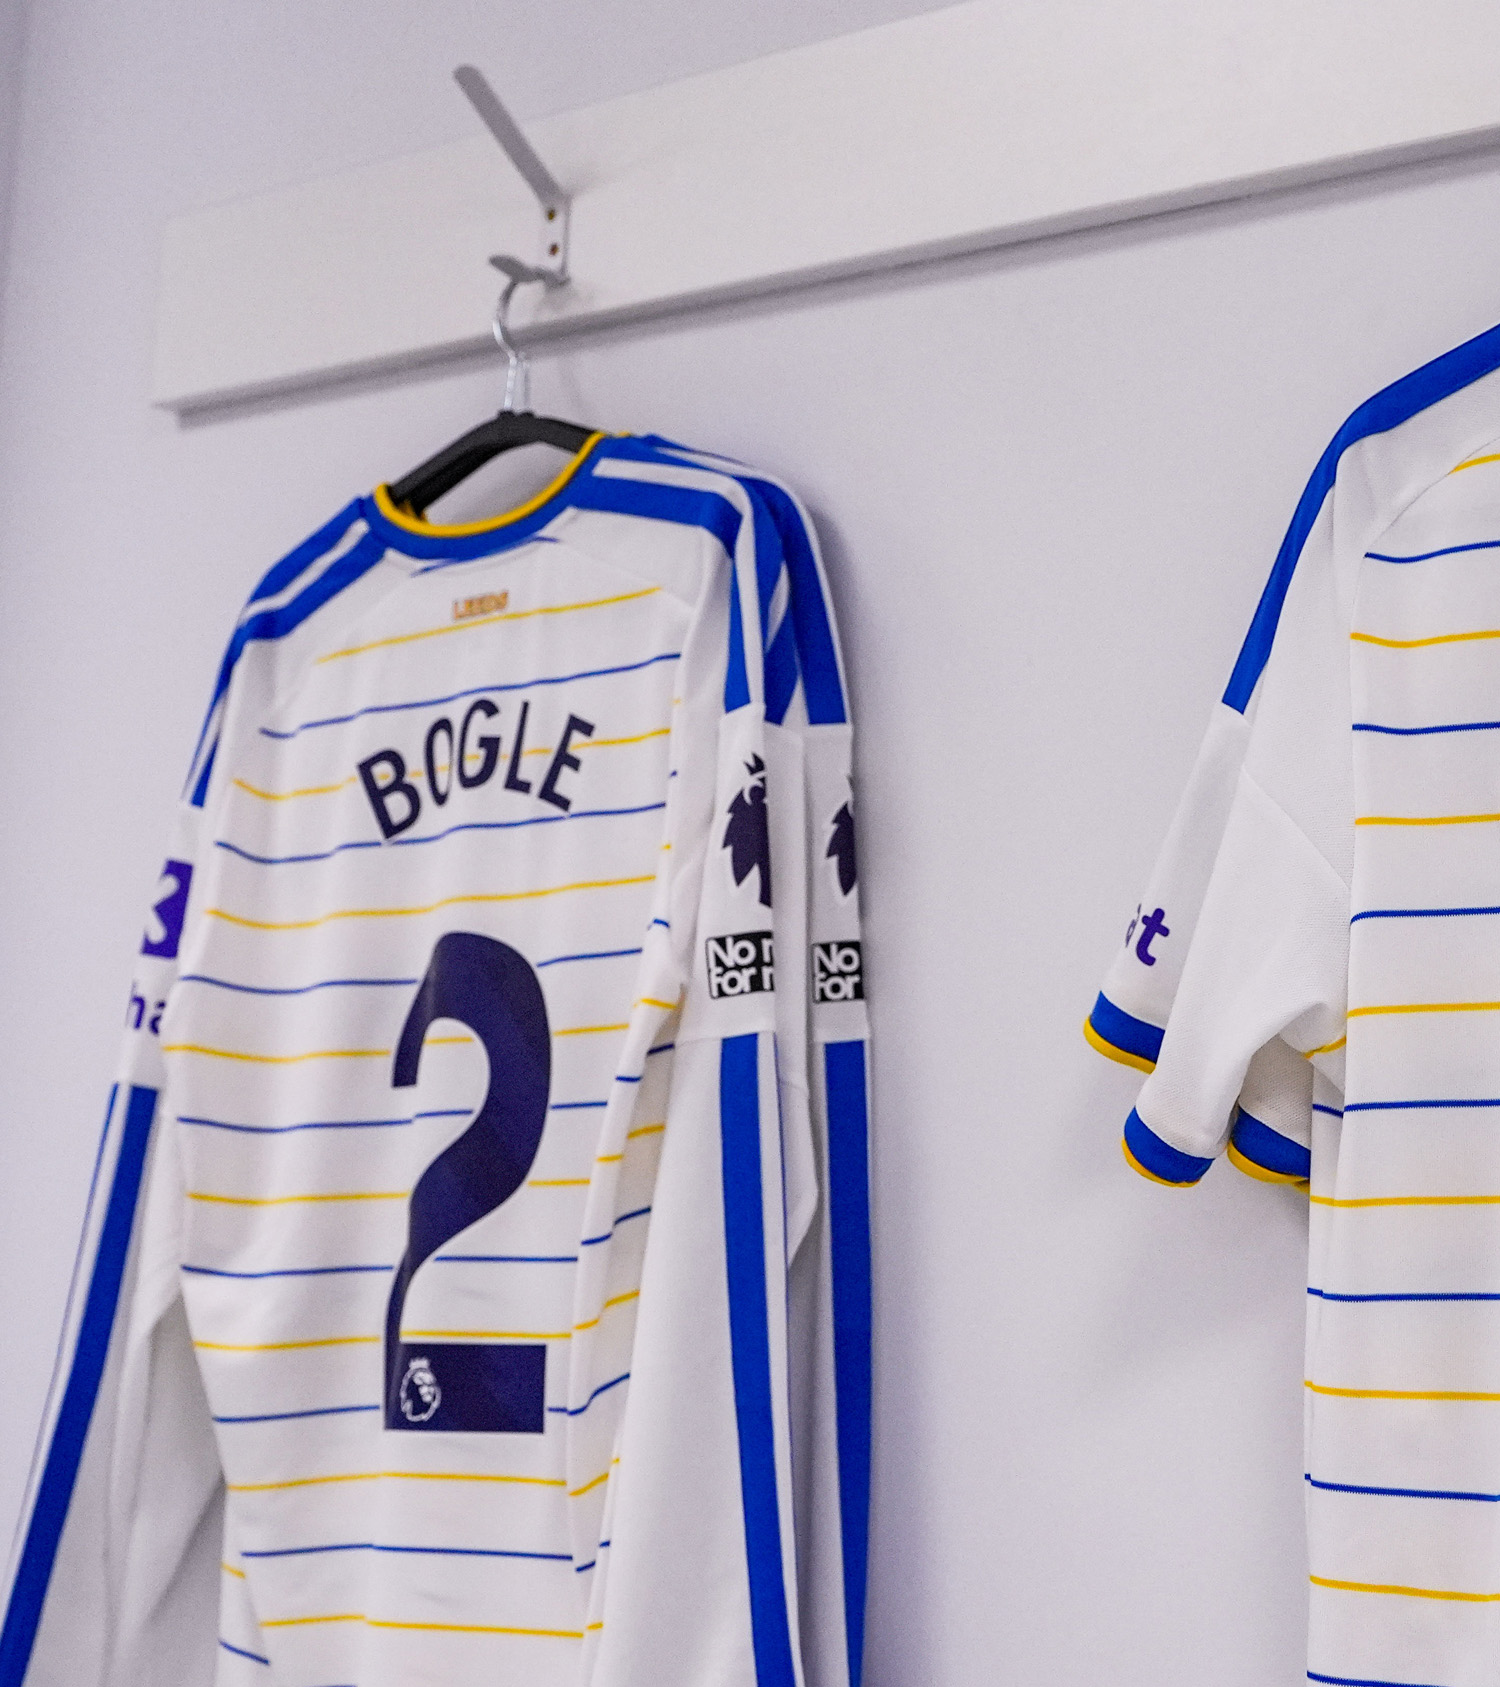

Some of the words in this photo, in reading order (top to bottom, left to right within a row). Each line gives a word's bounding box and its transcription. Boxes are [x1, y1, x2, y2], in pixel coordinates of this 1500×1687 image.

[356, 698, 595, 840] BOGLE
[707, 935, 757, 969] No
[812, 943, 860, 974] No
[384, 931, 551, 1433] 2
